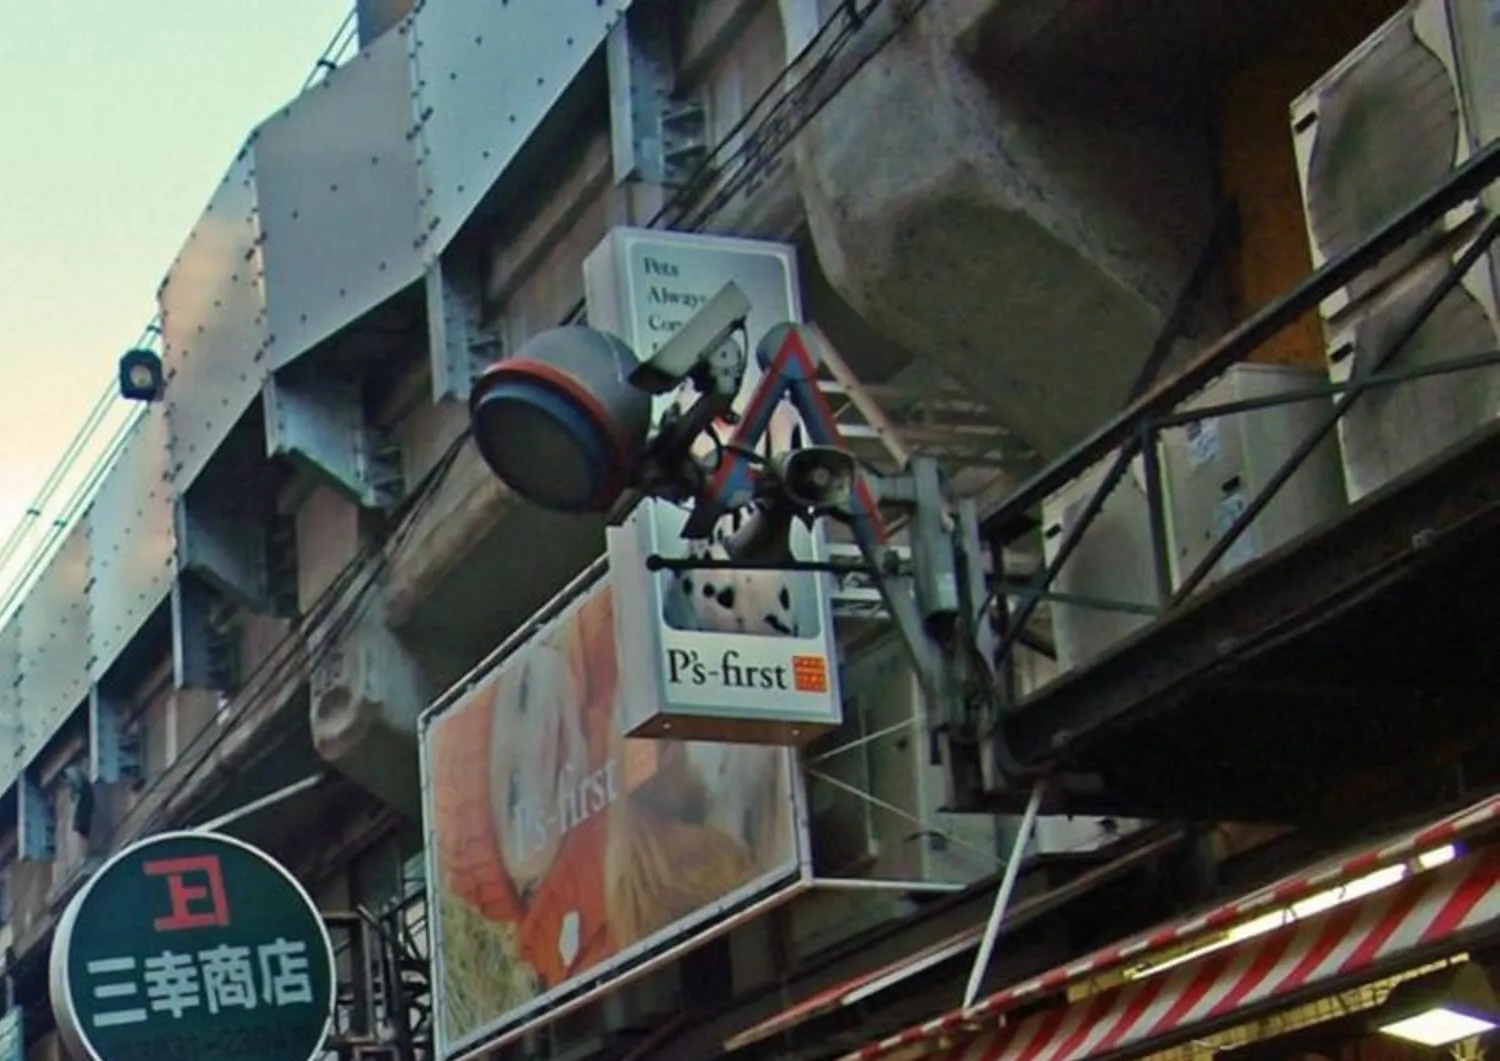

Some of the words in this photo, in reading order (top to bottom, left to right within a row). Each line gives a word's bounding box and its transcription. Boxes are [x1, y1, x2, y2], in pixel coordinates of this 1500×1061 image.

[667, 648, 789, 690] P's-first
[87, 937, 313, 1027] 三幸商店
